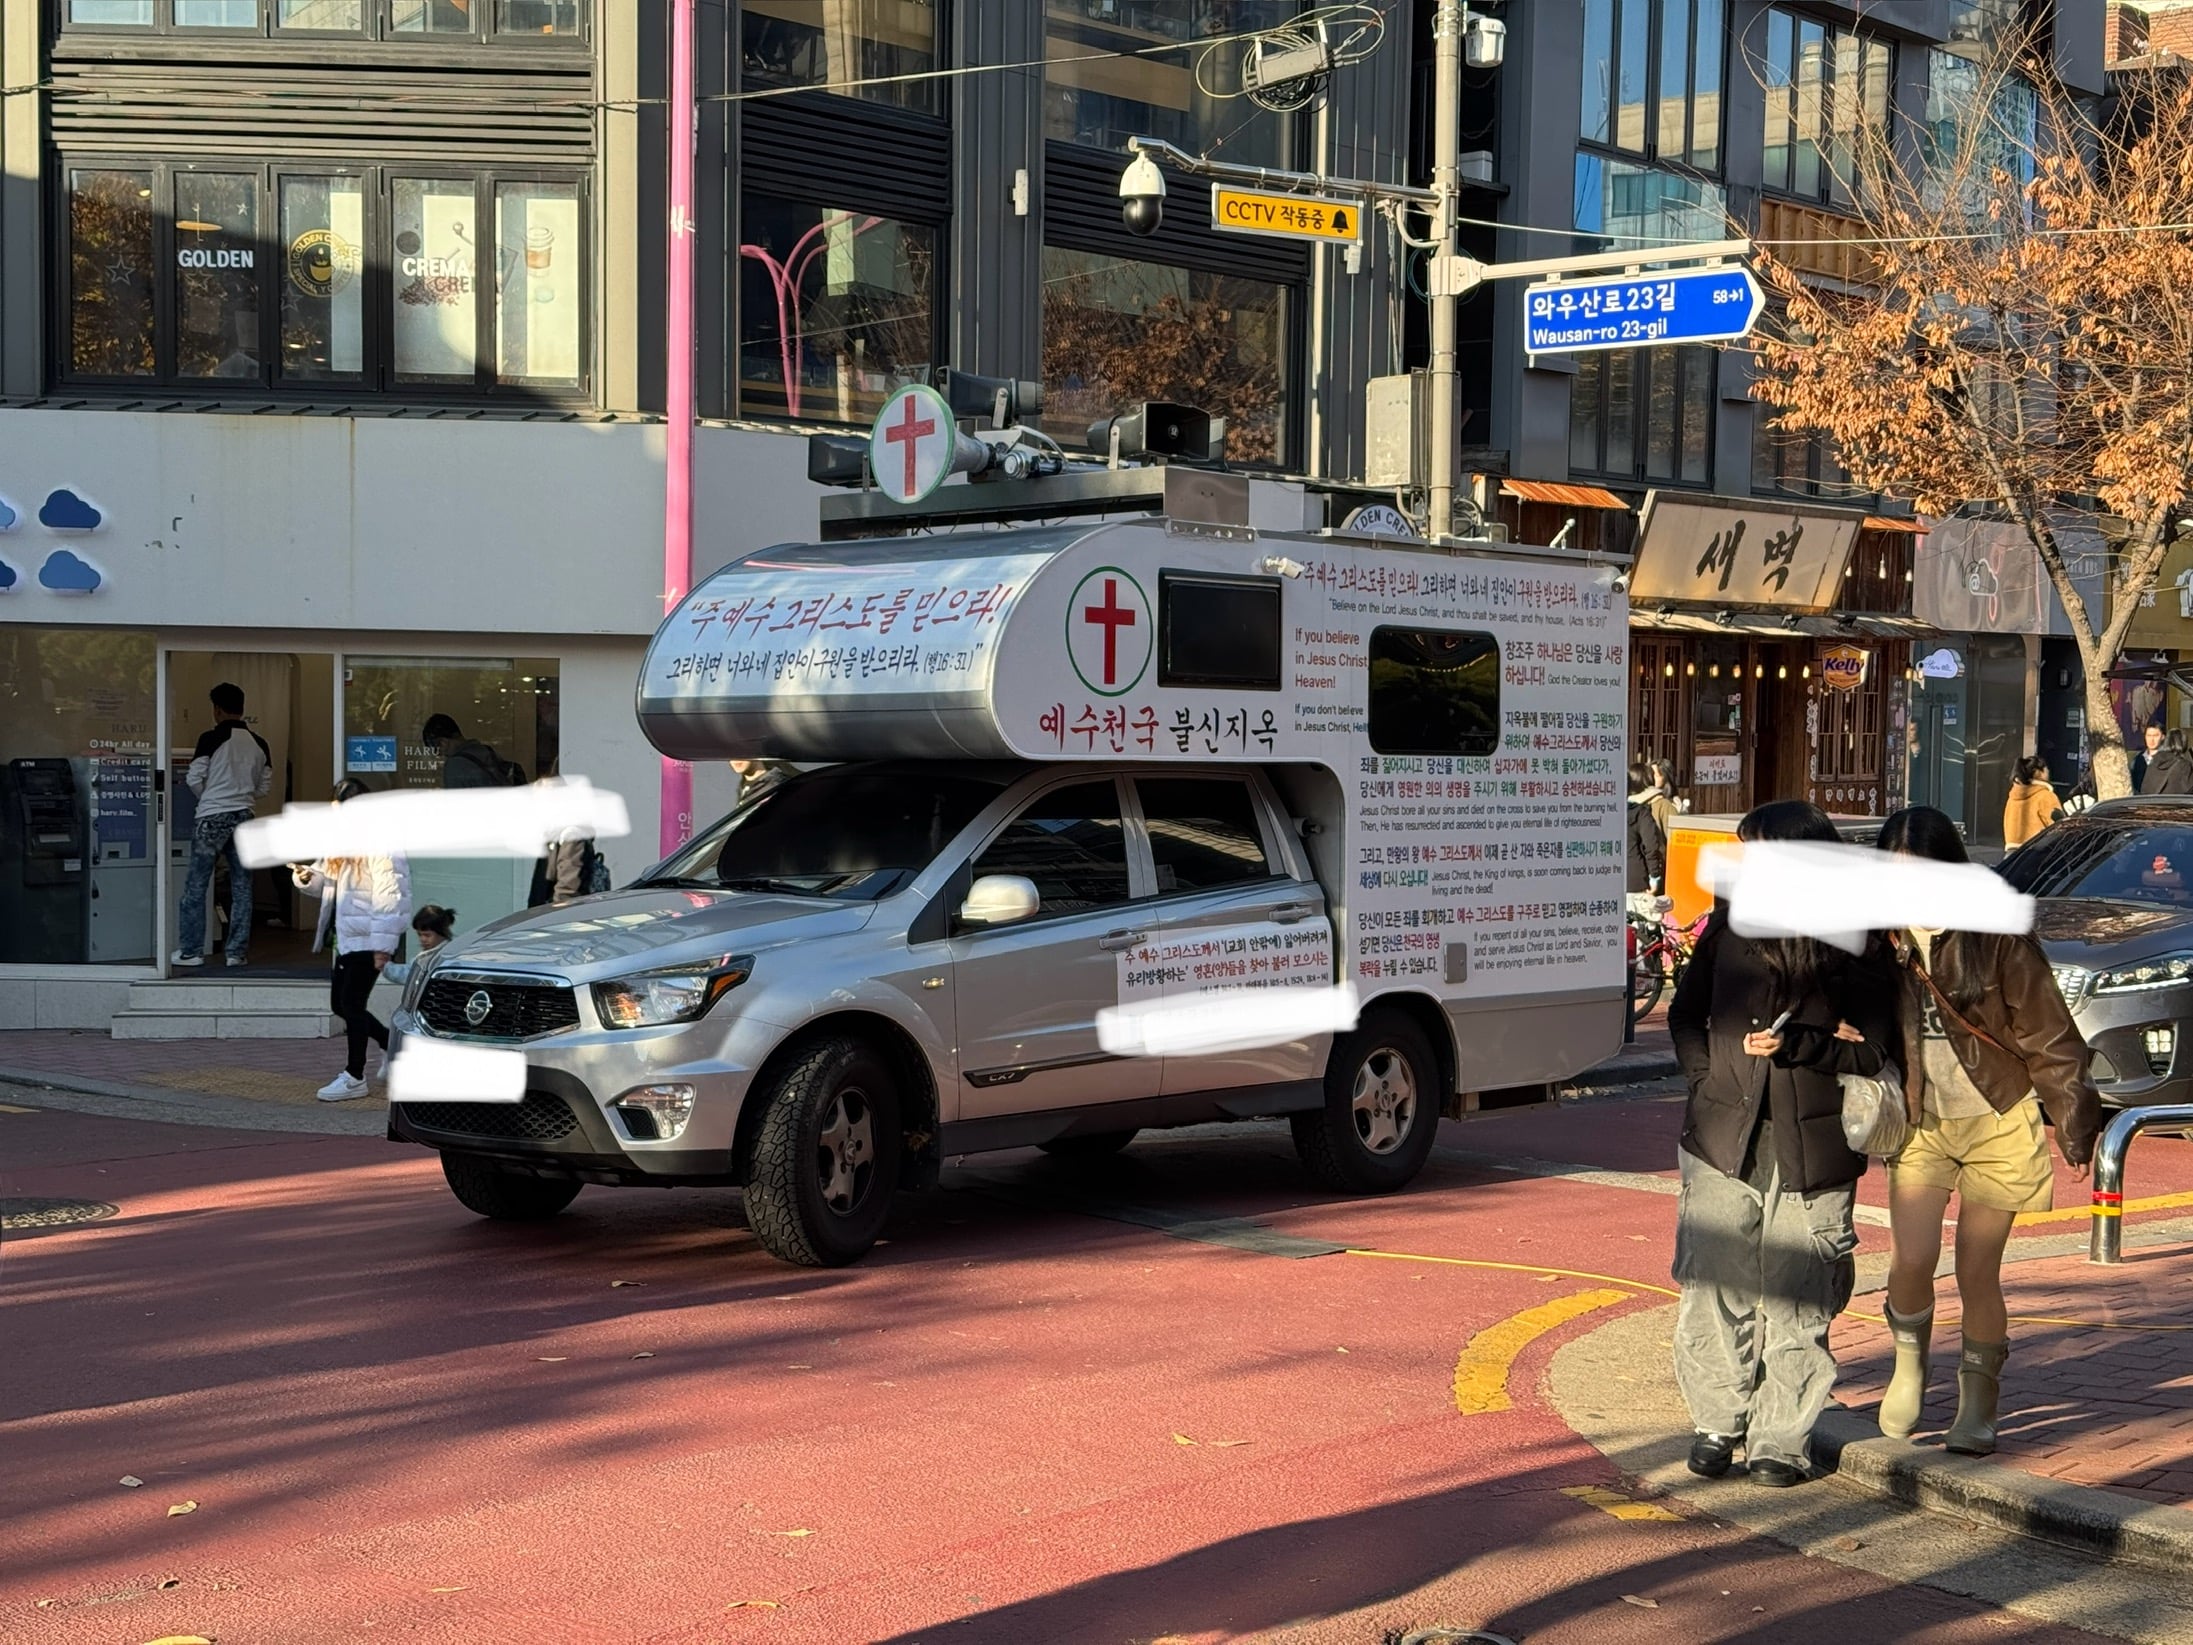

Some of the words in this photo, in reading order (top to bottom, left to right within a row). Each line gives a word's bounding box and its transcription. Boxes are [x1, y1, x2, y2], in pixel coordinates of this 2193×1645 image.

[1226, 200, 1276, 223] CCTV
[1280, 205, 1325, 230] 작동중
[178, 249, 254, 268] GOLDEN
[402, 257, 471, 277] CREMA
[1532, 281, 1675, 320] 와우산로23길
[1533, 325, 1617, 345] Wausan-ro
[1621, 318, 1667, 339] 23-gil
[1696, 514, 1803, 593] 새벽
[1369, 601, 1380, 613] the
[1382, 603, 1397, 615] Lord
[1398, 604, 1418, 616] Jesus
[1441, 607, 1455, 618] and
[1295, 628, 1302, 641] If
[1304, 631, 1323, 646] you
[1325, 629, 1360, 646] believe
[1295, 650, 1304, 664] in
[1307, 652, 1336, 666] Jesus
[1505, 640, 1534, 661] 창조주
[1536, 642, 1573, 662] 하나님은
[1575, 644, 1602, 664] 당신을
[1605, 645, 1623, 665] 사랑
[666, 652, 723, 683] 그리하면
[773, 647, 813, 681] 집안이
[813, 646, 858, 679] 구원을
[1824, 657, 1865, 676] Kelly
[1295, 673, 1336, 689] Heaven!
[1505, 665, 1545, 686] 하십니다!
[1561, 675, 1570, 685] the
[1302, 706, 1315, 717] you
[1317, 704, 1337, 715] don't
[1338, 705, 1363, 715] believe
[1039, 702, 1160, 754] 예수천국
[1168, 706, 1279, 755] 불신지옥
[1295, 720, 1302, 731] in
[1303, 721, 1326, 732] Jesus
[1328, 722, 1351, 734] Christ,
[1505, 711, 1538, 728] 지옥불에
[1566, 712, 1589, 729] 당신을
[1592, 713, 1623, 729] 구원하기
[121, 740, 133, 749] All
[135, 740, 150, 750] day
[404, 745, 440, 756] HARU
[1504, 734, 1530, 751] 위하여
[1600, 735, 1621, 751] 당신의
[101, 758, 128, 766] Credit
[130, 758, 151, 766] card
[407, 760, 438, 771] FILM
[1360, 757, 1379, 774] 죄를
[1427, 757, 1453, 775] 당신을
[1456, 758, 1490, 774] 대신하여
[1494, 758, 1527, 775] 십자가에
[1531, 758, 1539, 774] 못
[1542, 758, 1558, 774] 박혀
[101, 774, 118, 783] Self
[121, 774, 151, 783] button
[1360, 780, 1394, 798] 당신에게
[1397, 780, 1422, 798] 영원한
[1425, 781, 1442, 797] 의의
[1446, 781, 1471, 798] 생명을
[1474, 781, 1498, 797] 주시기
[1500, 780, 1516, 797] 위해
[1520, 781, 1559, 798] 부활하시고
[1561, 780, 1617, 797] 승천하셨습니다!
[1360, 804, 1378, 816] Jesus
[1457, 804, 1469, 815] and
[1496, 804, 1506, 814] the
[1361, 820, 1379, 833] Then,
[1391, 820, 1404, 831] has
[1442, 819, 1455, 830] and
[1359, 847, 1384, 865] 그리고,
[1387, 846, 1409, 864] 만왕의
[1411, 846, 1420, 863] 왕
[1484, 844, 1498, 860] 이제
[1501, 843, 1508, 860] 곧
[1510, 843, 1518, 860] 산
[1520, 842, 1534, 859] 자와
[1600, 840, 1613, 857] 위해
[1614, 840, 1622, 856] 이
[1359, 870, 1381, 889] 세상에
[1383, 870, 1397, 888] 다시
[1431, 870, 1450, 881] Jesus
[1473, 869, 1483, 880] the
[1484, 868, 1498, 880] King
[1549, 867, 1571, 877] coming
[1449, 884, 1462, 895] and
[1463, 884, 1474, 895] the
[1359, 912, 1384, 930] 당신이
[1385, 911, 1402, 928] 모든
[1403, 910, 1420, 928] 죄를
[1421, 908, 1455, 926] 회개하고
[1457, 907, 1474, 924] 예수
[1475, 905, 1515, 922] 그리스도를
[1517, 903, 1541, 920] 구주로
[1541, 902, 1557, 919] 믿고
[1588, 900, 1619, 917] 순종하여
[1359, 936, 1380, 955] 섬기면
[1381, 934, 1403, 953] 당신은
[1403, 933, 1424, 951] 천국의
[1425, 932, 1440, 950] 영생
[1507, 944, 1525, 955] Jesus
[1124, 951, 1136, 966] 주
[1139, 948, 1159, 964] 예수
[1162, 942, 1220, 961] 그리스도께서
[1193, 960, 1247, 981] 영혼(양)들을
[1250, 955, 1269, 974] 찾아
[1271, 954, 1290, 971] 불러
[1293, 951, 1329, 968] 모으시는
[1382, 959, 1397, 976] 누릴
[1400, 958, 1408, 975] 수
